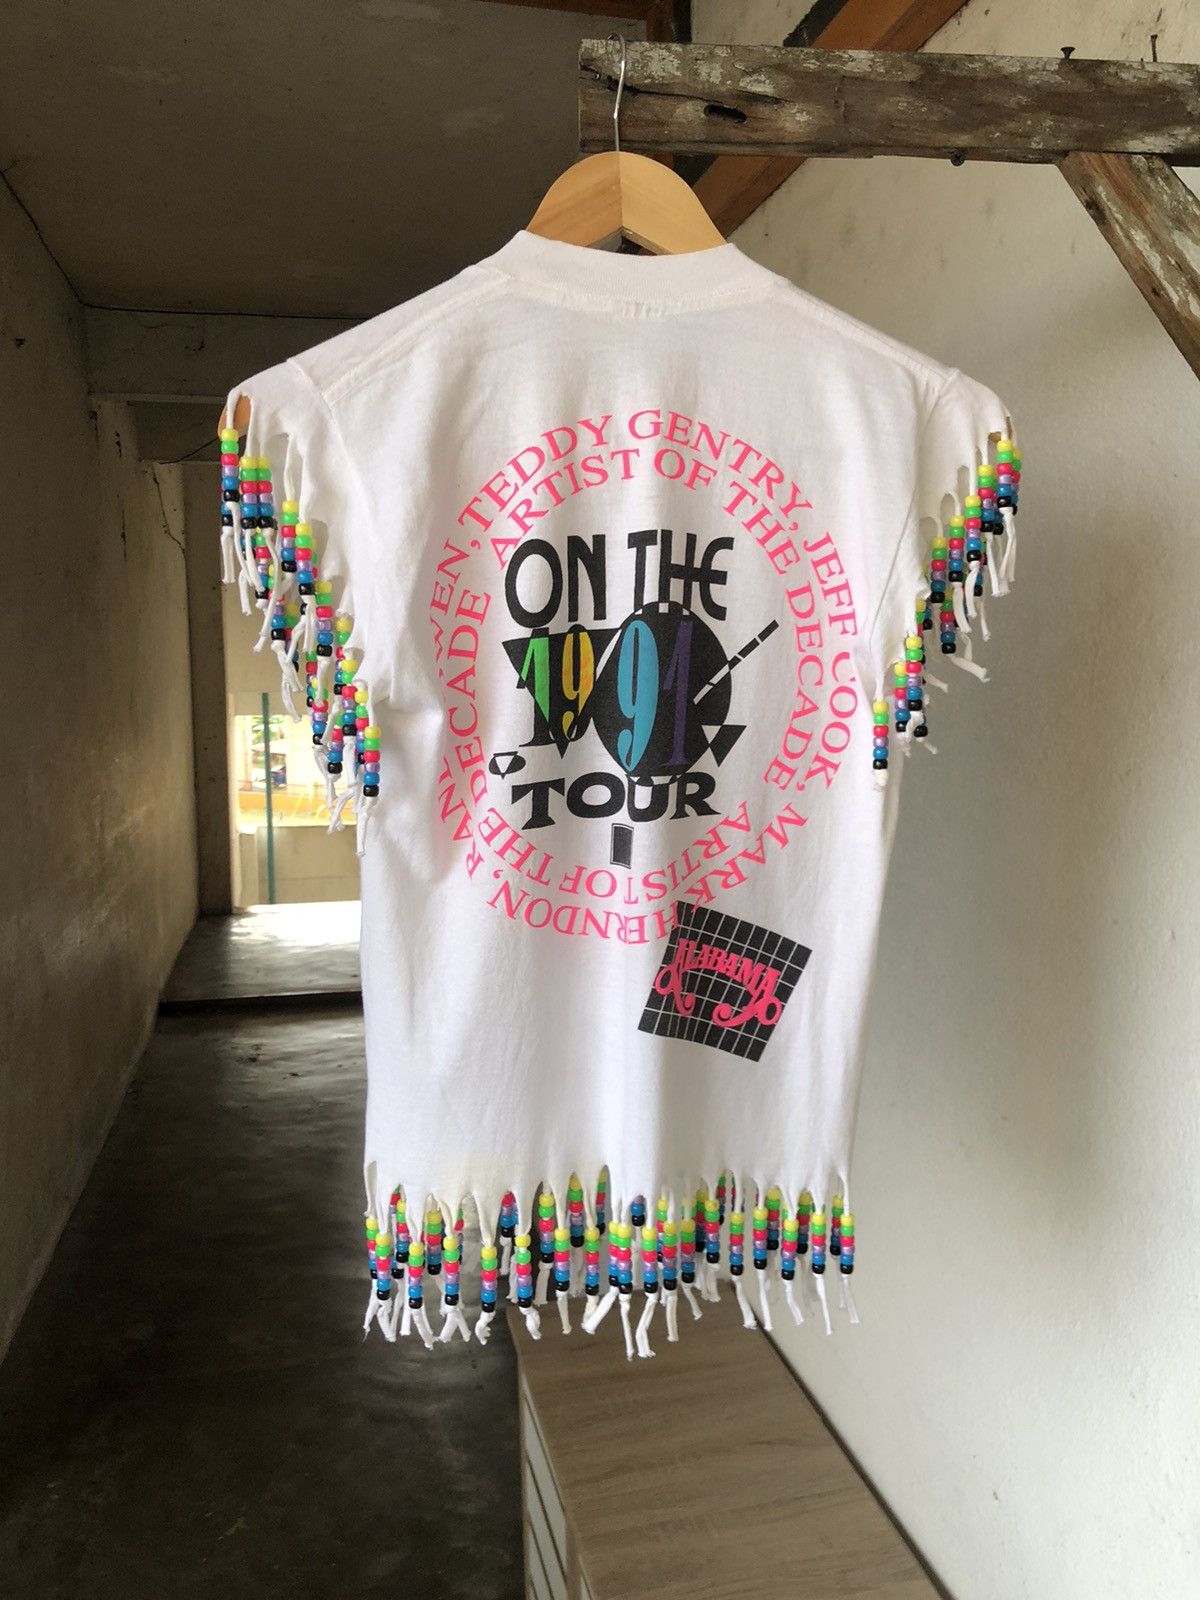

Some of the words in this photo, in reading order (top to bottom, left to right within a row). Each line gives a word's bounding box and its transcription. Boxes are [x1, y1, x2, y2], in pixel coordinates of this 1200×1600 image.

[457, 415, 612, 532] TEDDY
[628, 409, 813, 532] GENTRY,
[490, 448, 640, 569] ARTIST
[653, 448, 717, 491] OF
[723, 481, 800, 575] THE
[762, 581, 825, 791] DECADE
[505, 534, 606, 628] ON
[627, 529, 735, 621] THE
[802, 532, 858, 636] JEFF
[446, 588, 491, 806] DECADE
[516, 620, 694, 772] 1991
[480, 807, 553, 888] THE
[511, 772, 721, 830] TOUR
[624, 801, 750, 905] ARTIST
[556, 865, 617, 898] OF
[685, 804, 808, 913] MARK
